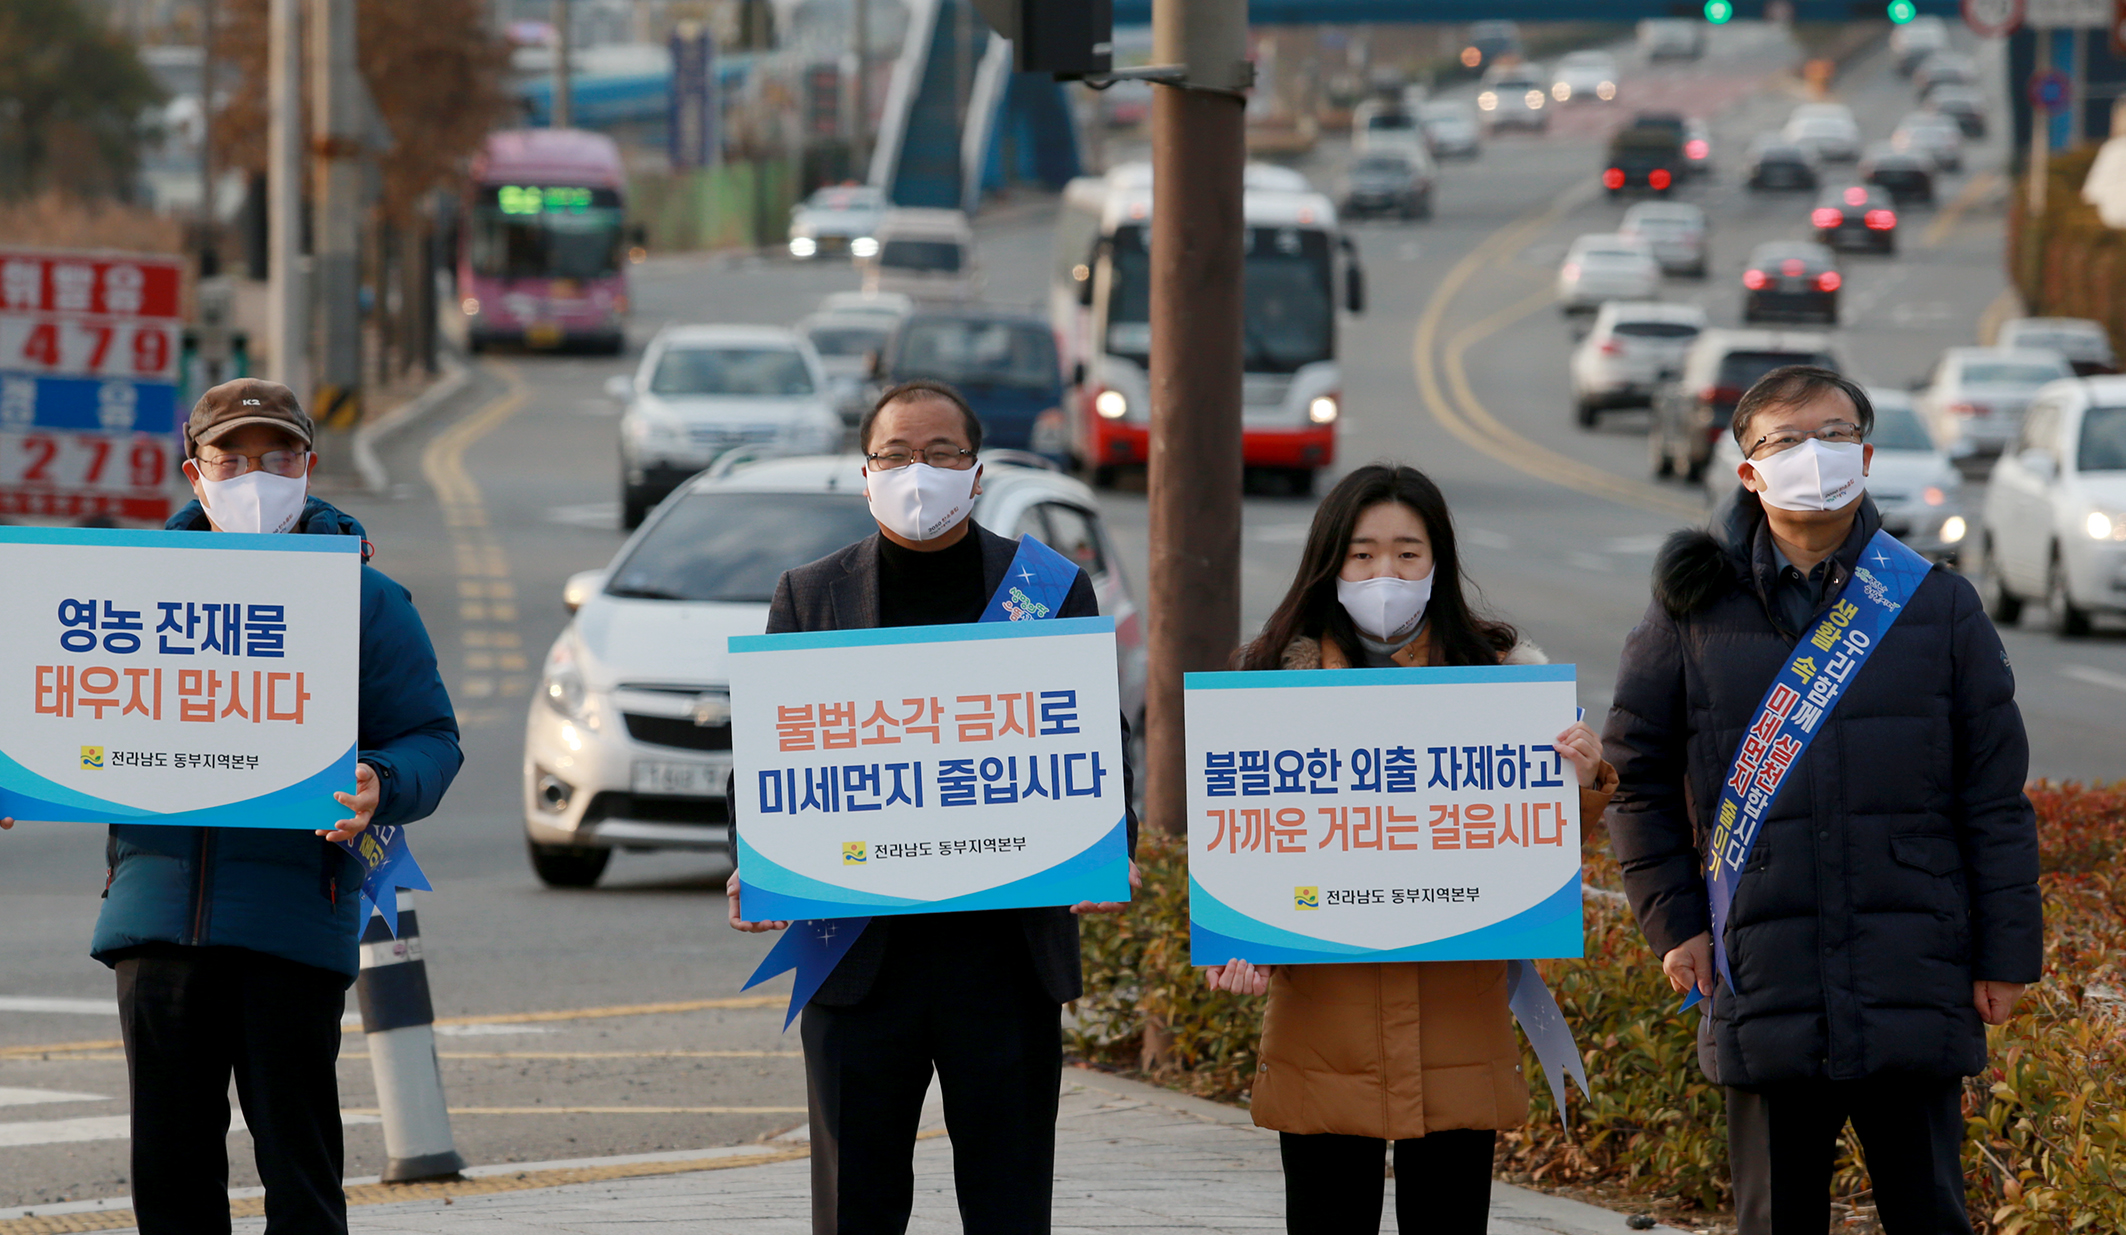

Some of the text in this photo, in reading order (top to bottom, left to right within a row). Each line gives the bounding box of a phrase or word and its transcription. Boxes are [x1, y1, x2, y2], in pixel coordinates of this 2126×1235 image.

[242, 398, 261, 406] K2
[57, 597, 288, 658] 영농 잔재물
[1009, 587, 1037, 614] 생명의
[1036, 602, 1050, 618] 땅
[34, 664, 311, 725] 태우지 맙시다
[775, 689, 1081, 752] 불법소각 금지로
[111, 750, 260, 771] 전라남도 동부지역본부
[1708, 598, 1860, 882] 생활 속 미세먼지 줄이기
[758, 760, 925, 815] 미세먼지
[936, 751, 1107, 808] 줄입시다
[1204, 743, 1564, 797] 불필요한 외출 자제하고
[1206, 801, 1568, 854] 가까운 거리는 걸읍시다
[1725, 733, 1803, 872] 실천합시다
[359, 832, 385, 868] 줄이
[874, 836, 1027, 860] 전라남도 동부지역본부
[1326, 886, 1481, 906] 전라남도 동부지역본부
